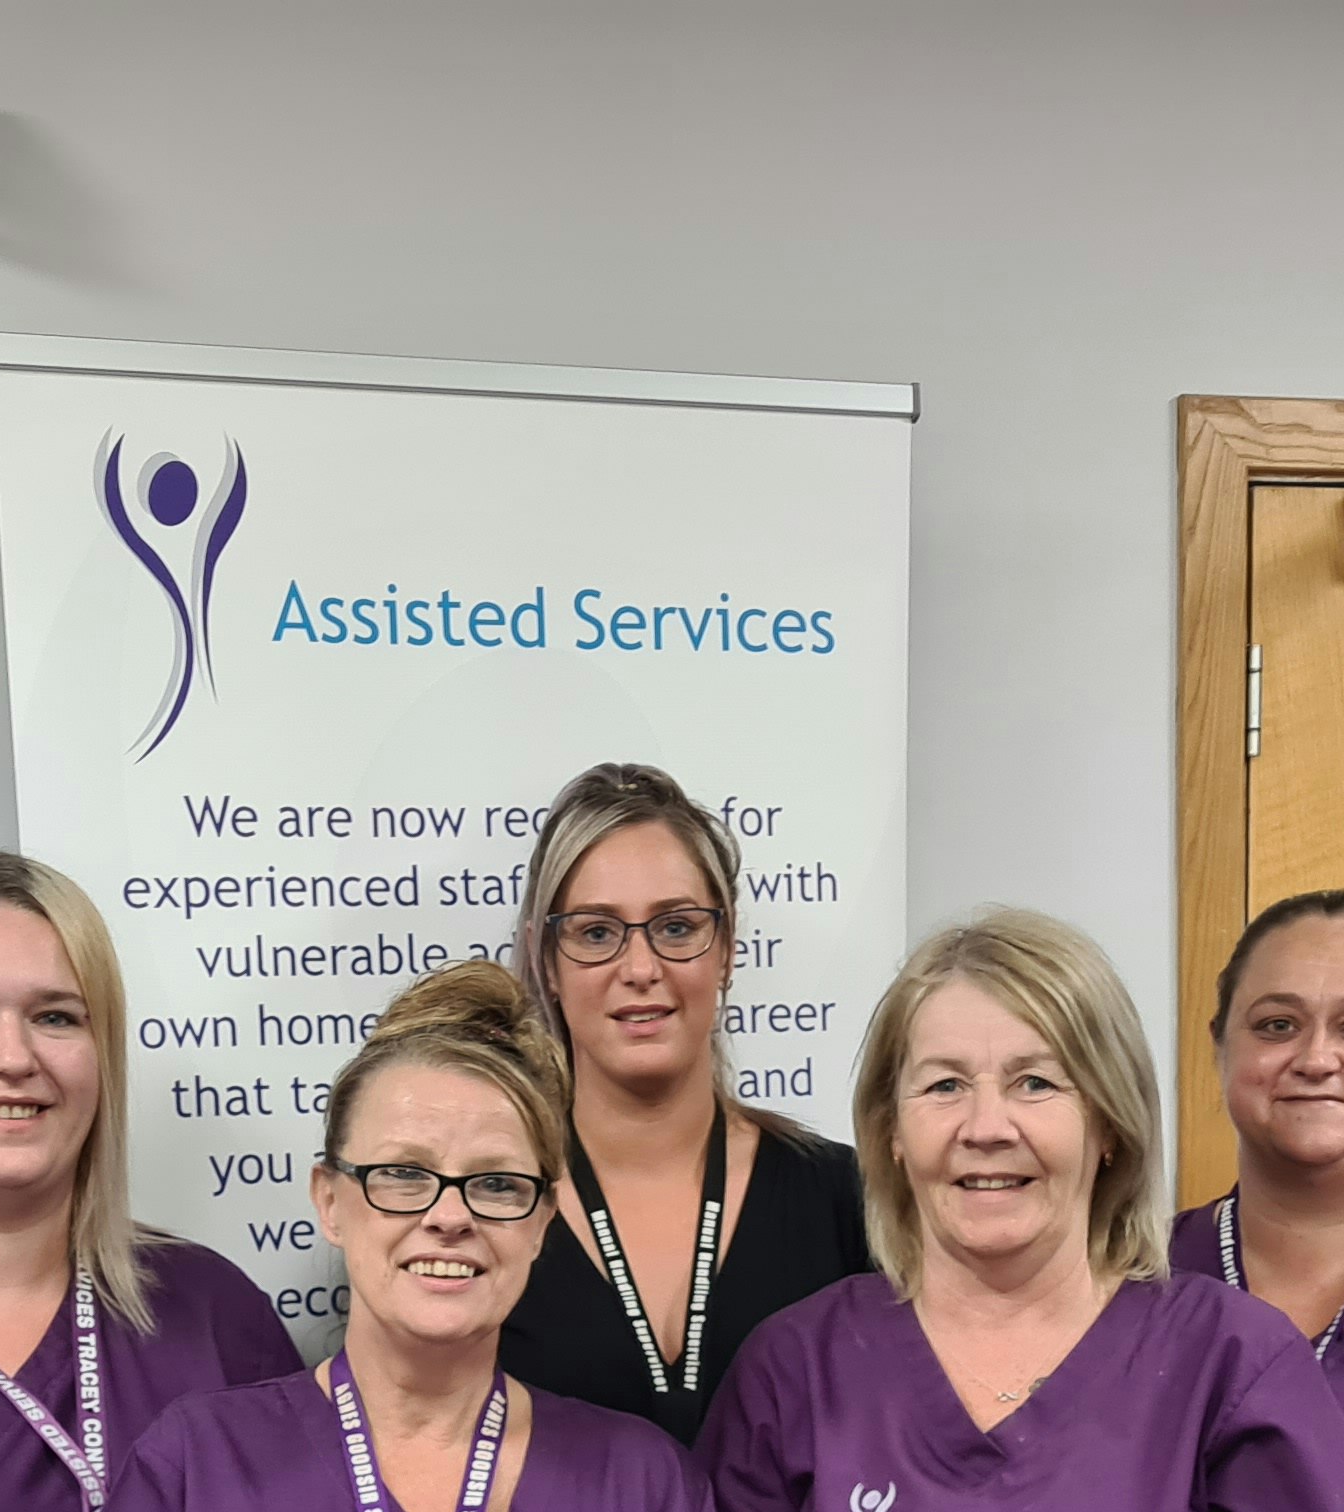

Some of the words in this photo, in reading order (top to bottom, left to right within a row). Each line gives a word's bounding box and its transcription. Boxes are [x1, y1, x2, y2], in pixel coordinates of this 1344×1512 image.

[272, 580, 545, 648] Assisted
[574, 589, 834, 654] Services
[184, 796, 257, 837] We
[279, 807, 352, 837] are
[373, 808, 465, 837] now
[722, 796, 783, 837] for
[124, 865, 419, 919] experienced
[440, 864, 525, 905] staf
[746, 862, 836, 902] with
[195, 933, 449, 978] vulnerable
[733, 929, 783, 968] eir
[140, 1017, 237, 1049] own
[724, 1000, 838, 1034] areer
[172, 1075, 272, 1118] that
[737, 1057, 812, 1099] and
[209, 1153, 291, 1196] you
[248, 1221, 314, 1252] we
[77, 1334, 101, 1413] TRACEY
